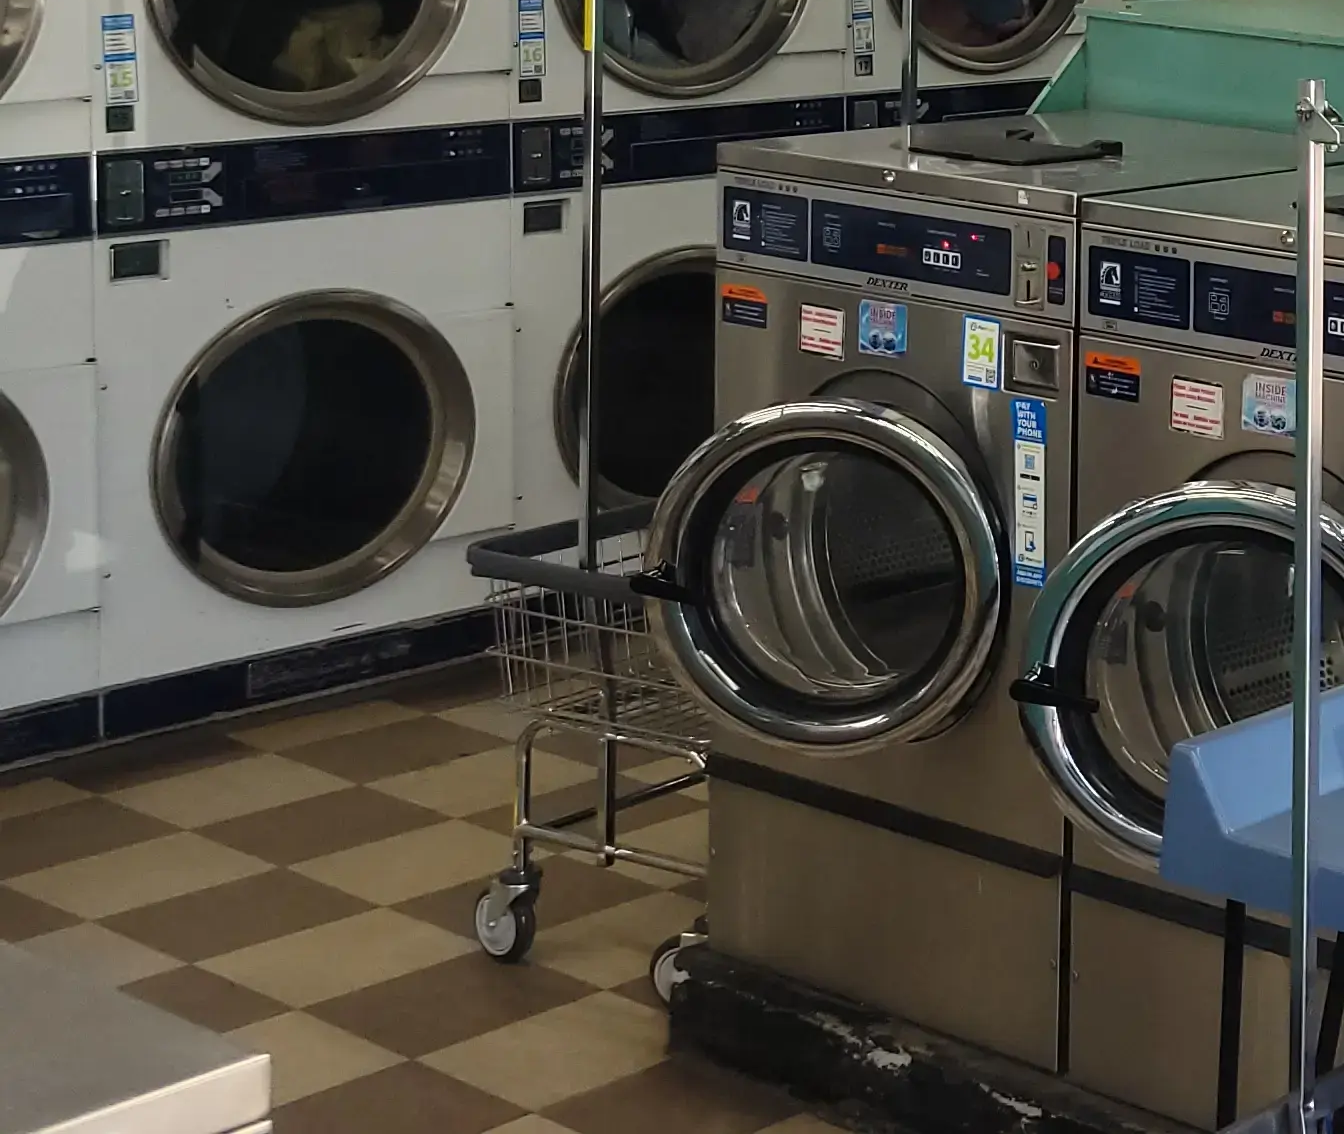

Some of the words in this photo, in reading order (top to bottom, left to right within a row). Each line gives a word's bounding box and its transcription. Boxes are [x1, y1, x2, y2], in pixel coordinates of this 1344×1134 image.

[523, 48, 542, 62] 16
[110, 69, 133, 88] 15
[867, 277, 908, 291] DEXTER
[968, 334, 994, 363] 34
[1260, 347, 1297, 361] DEXT
[1255, 382, 1287, 395] INSIDE
[1016, 401, 1030, 410] PAY
[1017, 410, 1035, 419] WITH
[1017, 419, 1037, 428] YOUR
[1017, 427, 1042, 438] PHONE
